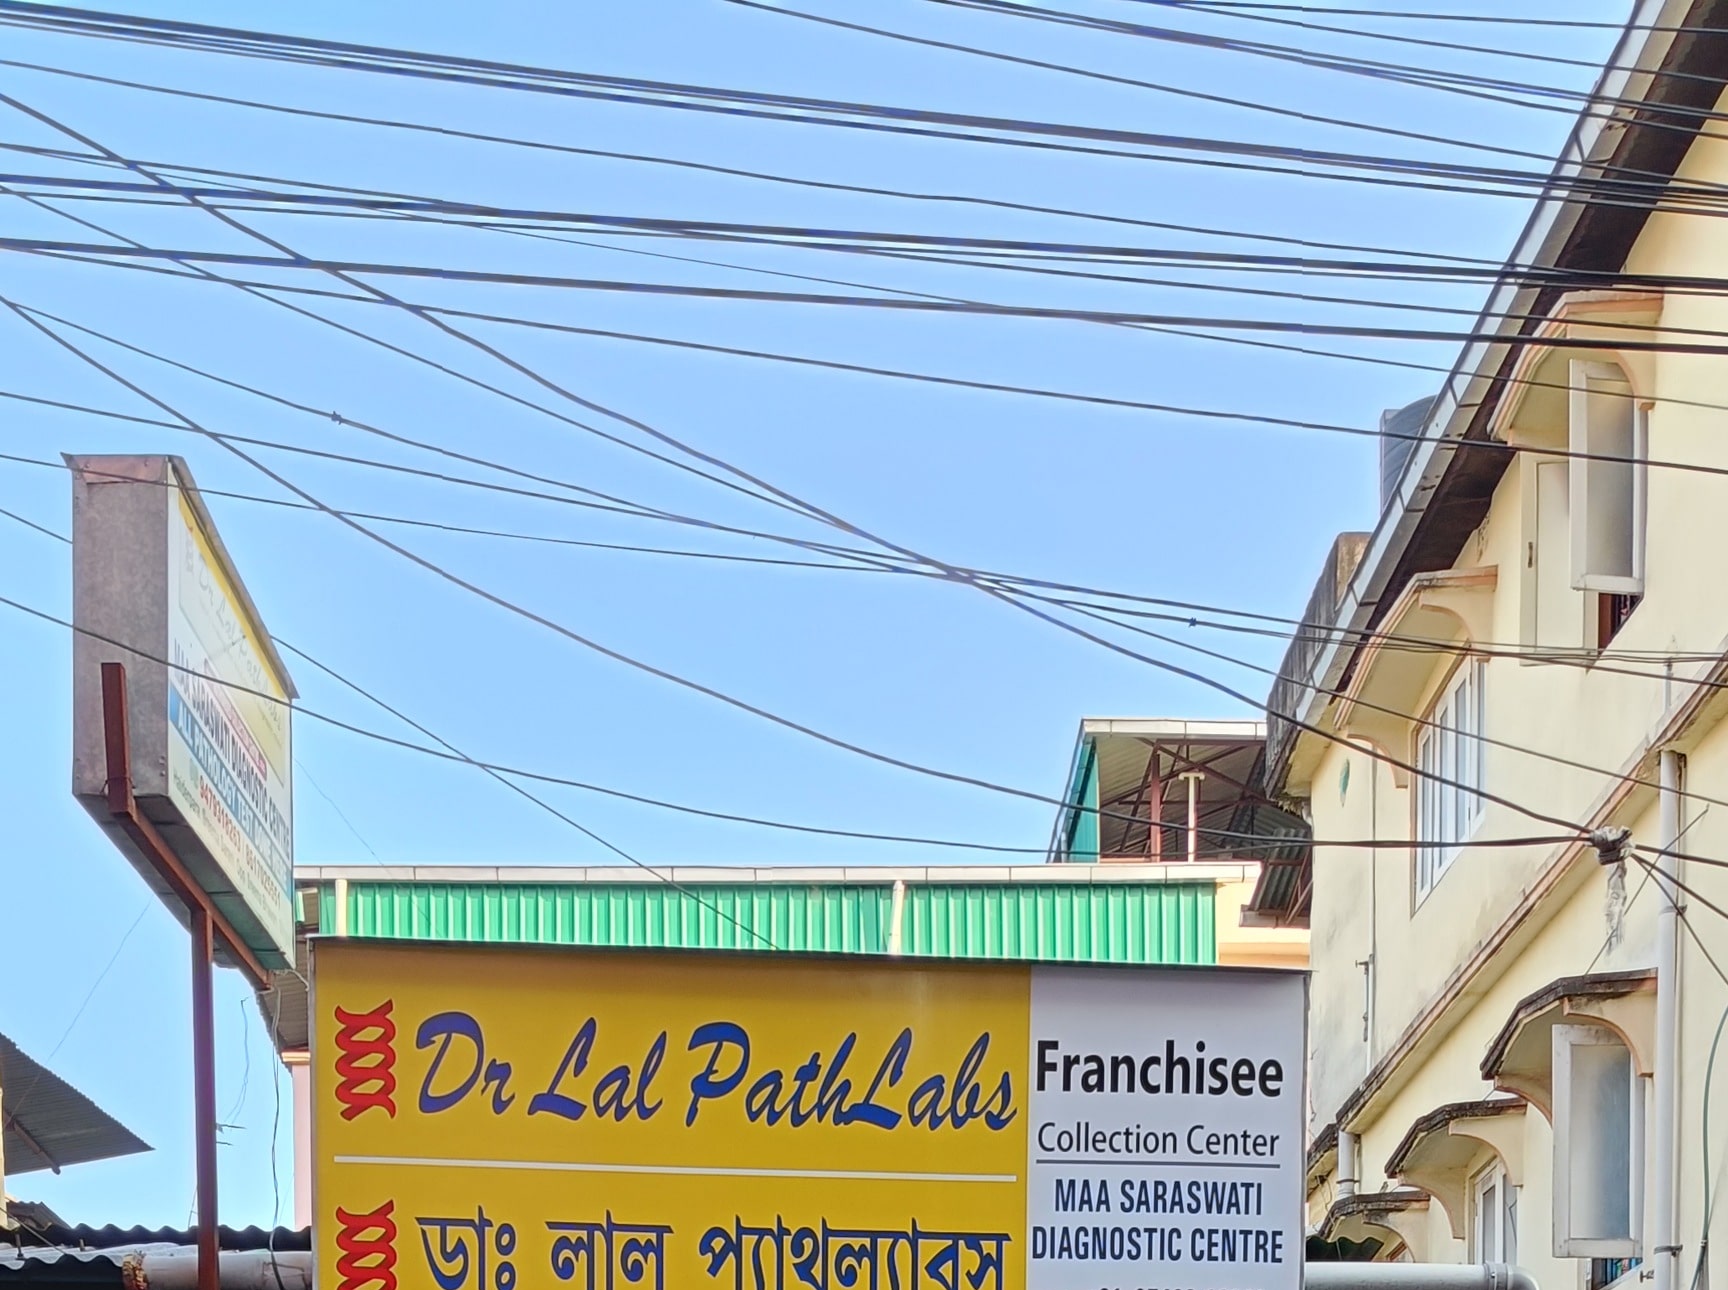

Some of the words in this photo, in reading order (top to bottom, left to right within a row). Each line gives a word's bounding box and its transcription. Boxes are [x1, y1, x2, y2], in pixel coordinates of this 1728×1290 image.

[415, 1010, 517, 1116] Dr
[529, 1016, 668, 1122] Lal
[685, 1019, 1019, 1131] PathLabs
[1036, 1039, 1284, 1097] Franchisee
[1038, 1121, 1177, 1154] Collection
[1186, 1124, 1280, 1156] Center
[1055, 1179, 1111, 1212] MAA
[1120, 1180, 1262, 1215] SARASWATI
[1032, 1226, 1182, 1261] DIAGNOSTIC
[1190, 1228, 1283, 1263] CENTRE
